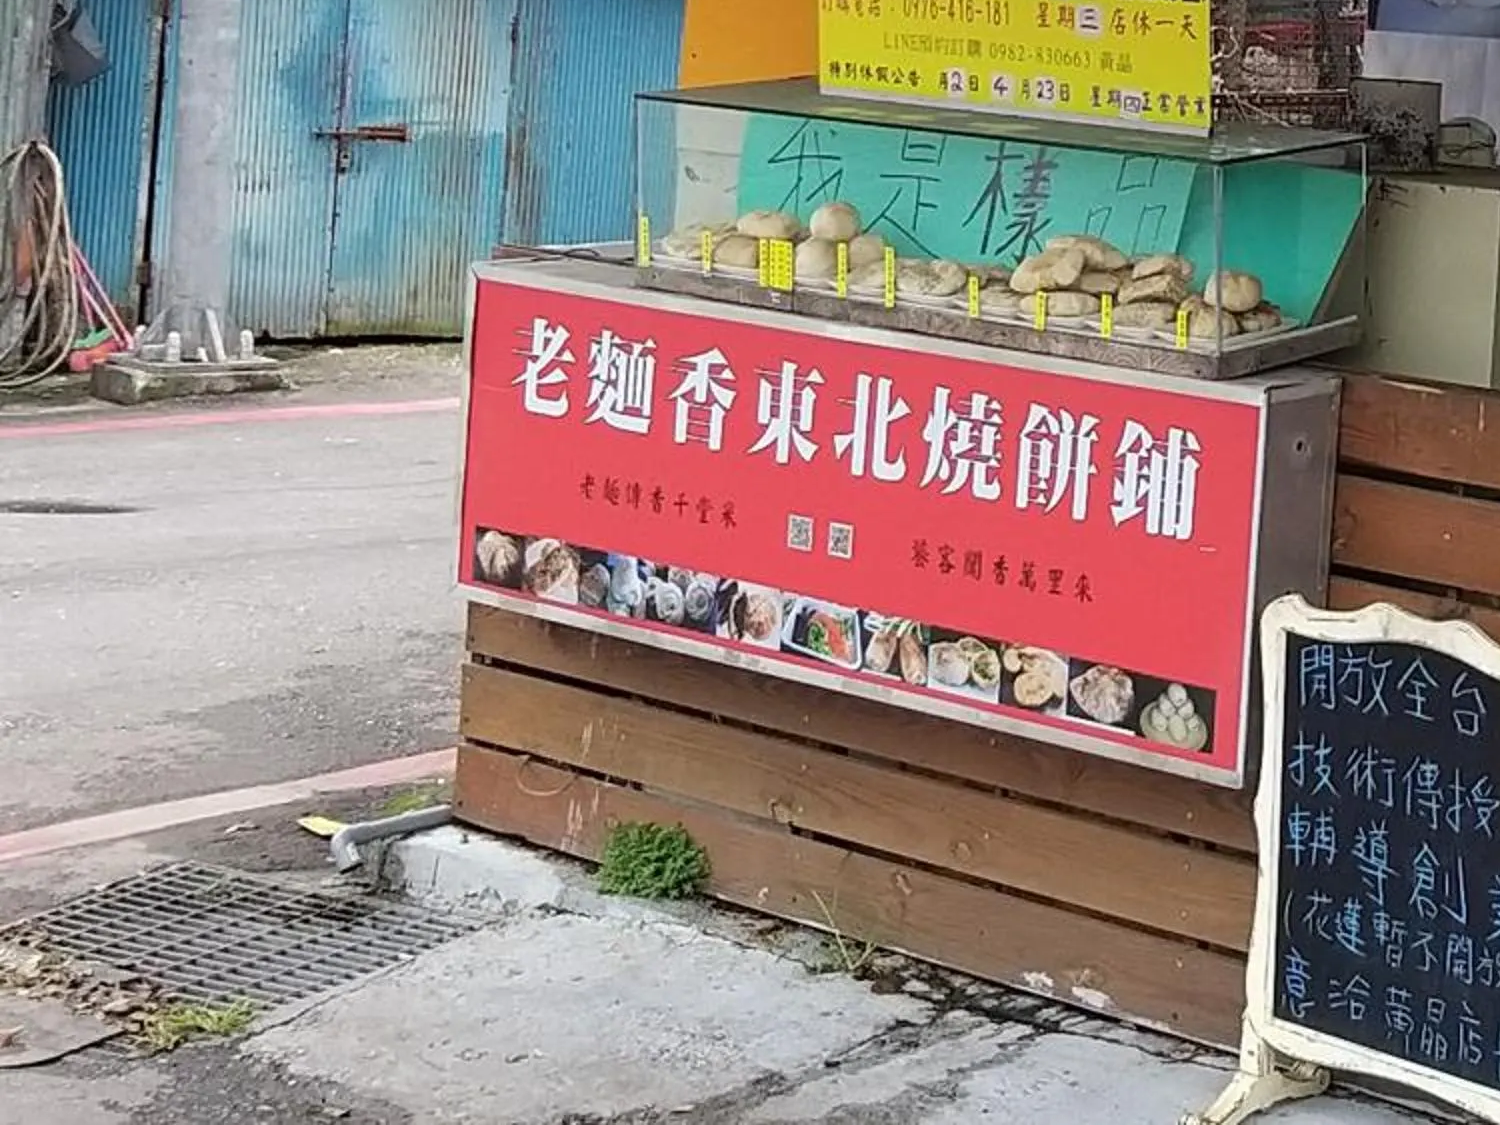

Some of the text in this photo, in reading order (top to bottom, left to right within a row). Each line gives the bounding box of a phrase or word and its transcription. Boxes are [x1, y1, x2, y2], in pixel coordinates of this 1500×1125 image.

[767, 120, 1168, 267] 我是樣品
[511, 316, 1202, 542] 老麵香東北燒餅鋪
[1300, 643, 1488, 739] 開放全台
[1287, 730, 1500, 839] 技術傳授
